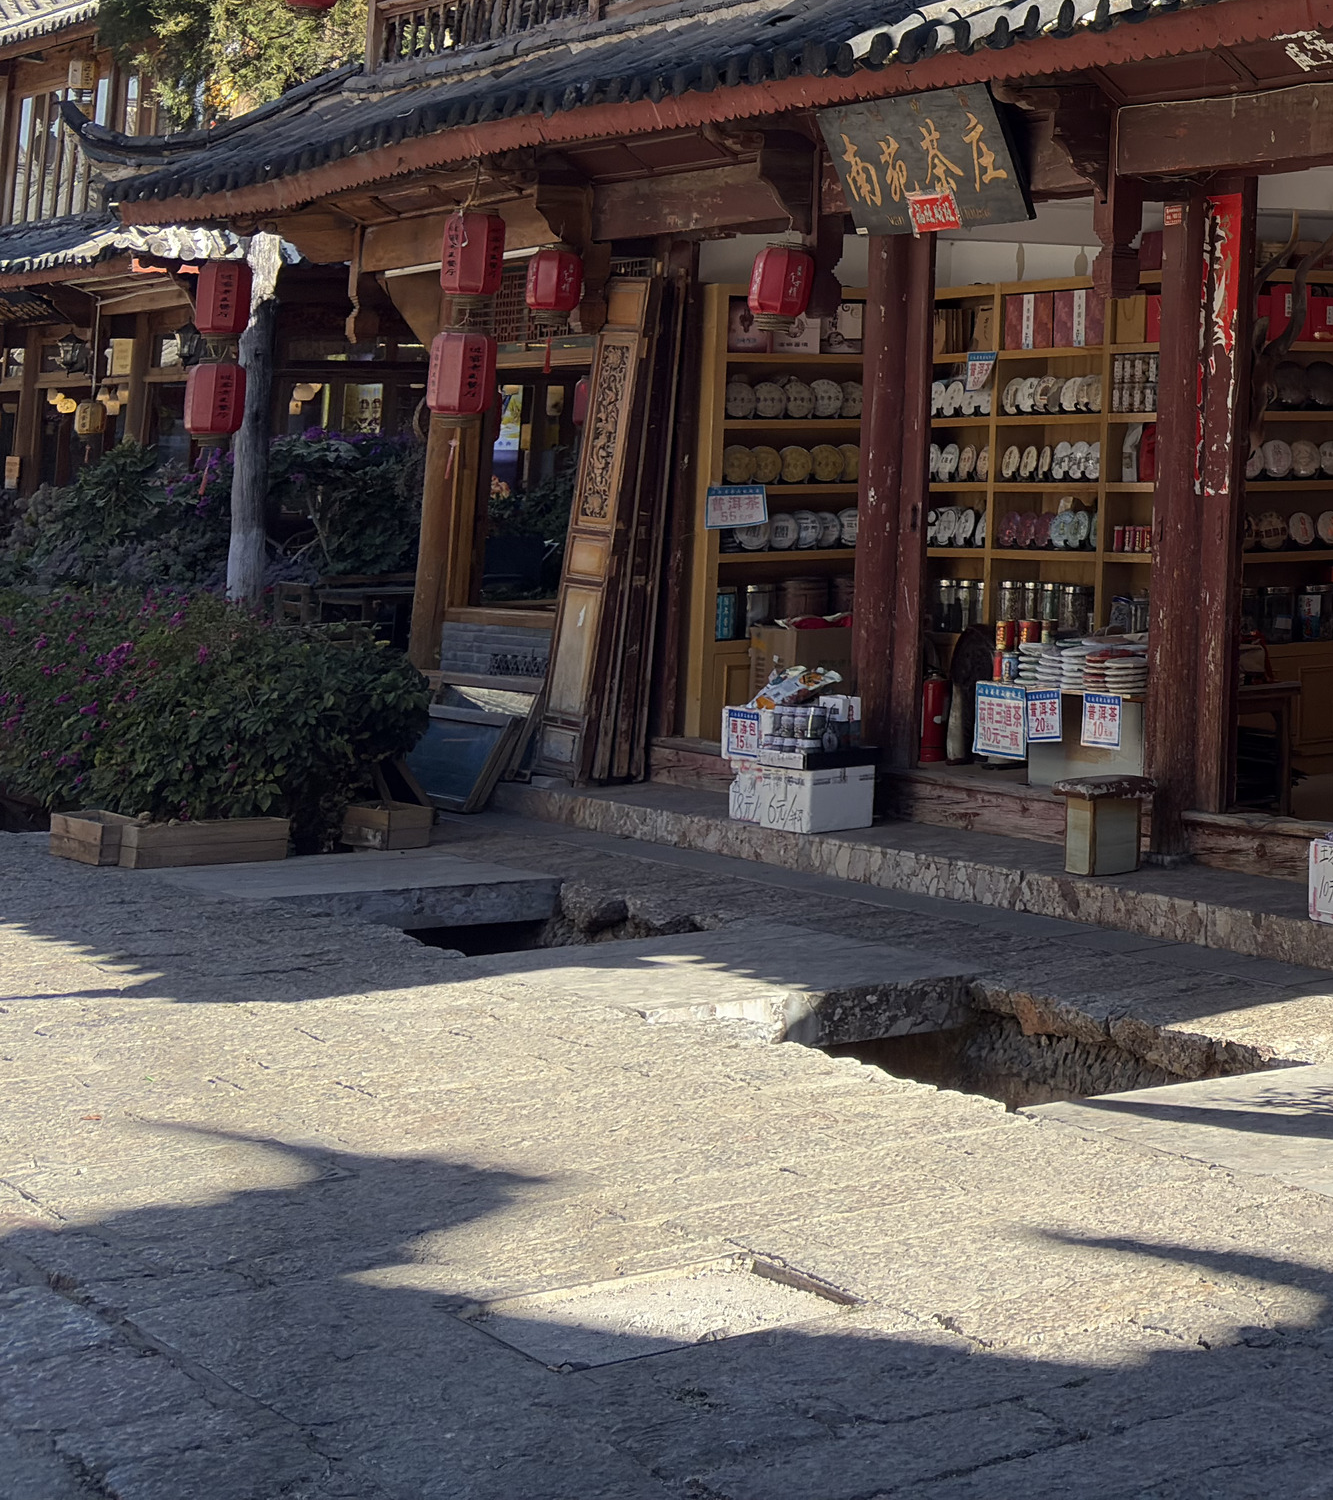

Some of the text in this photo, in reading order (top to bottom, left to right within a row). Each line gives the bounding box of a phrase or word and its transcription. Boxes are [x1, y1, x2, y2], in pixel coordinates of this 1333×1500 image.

[710, 495, 761, 512] 普洱茶
[978, 700, 1022, 728] 云南三道茶
[1029, 700, 1058, 718] 普洱茶
[1087, 703, 1118, 723] 普洱茶
[731, 719, 757, 736] 菌汤包
[982, 726, 1020, 747] 10元一瓶
